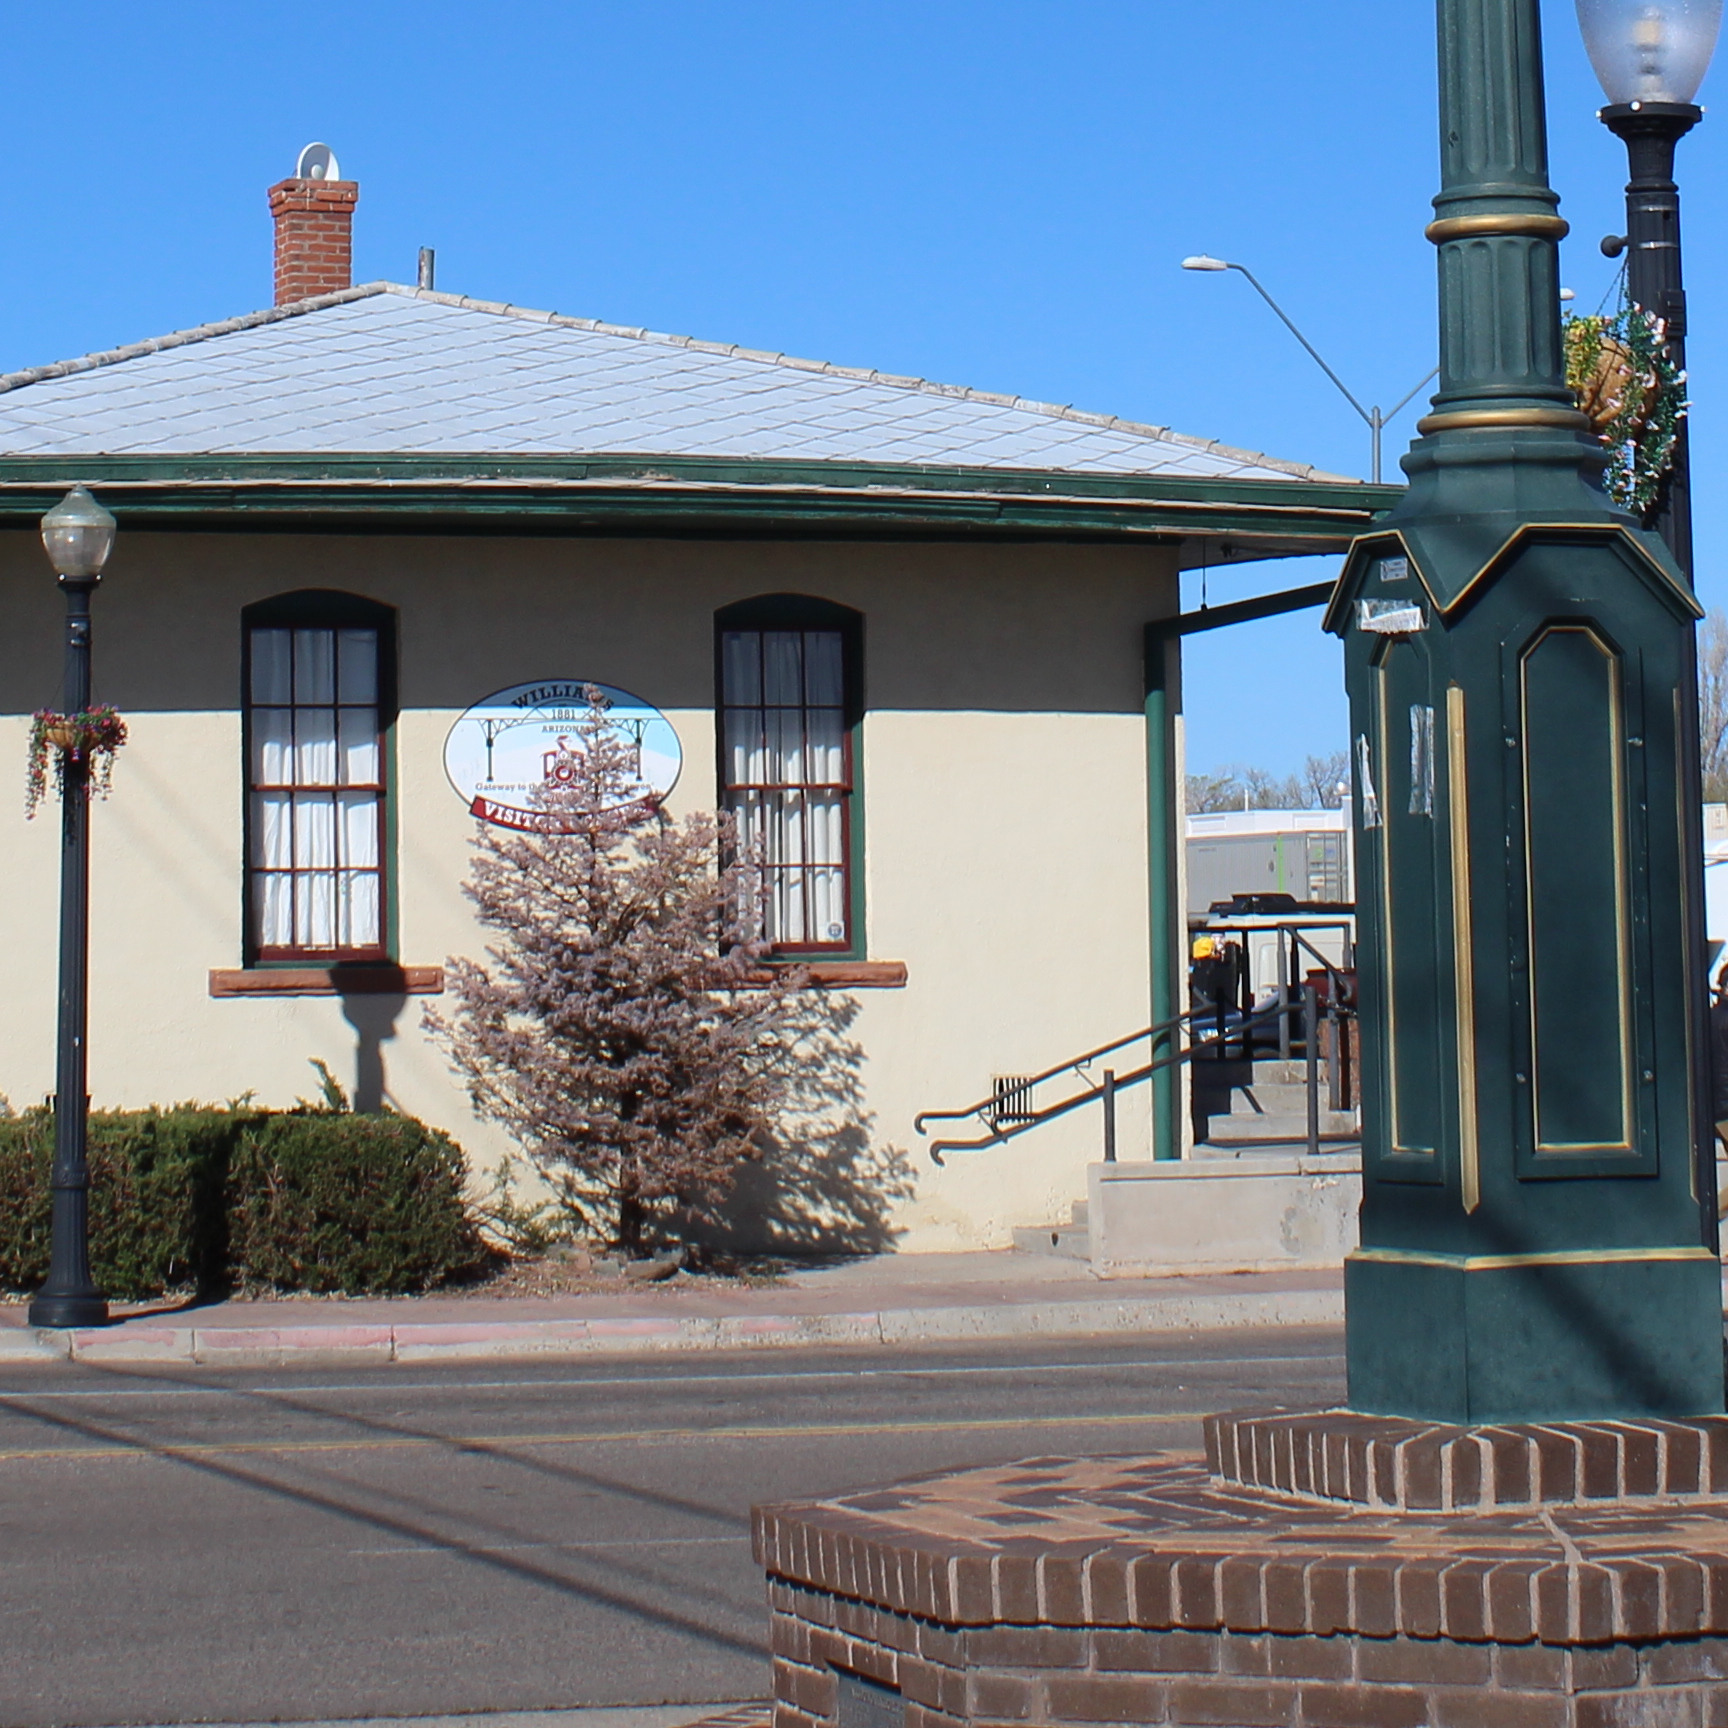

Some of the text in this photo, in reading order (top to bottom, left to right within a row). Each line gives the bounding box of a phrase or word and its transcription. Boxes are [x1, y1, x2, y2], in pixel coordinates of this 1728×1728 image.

[511, 684, 615, 709] WILLIAS
[551, 708, 576, 720] 1881
[475, 782, 515, 794] Gateway
[518, 782, 529, 791] to
